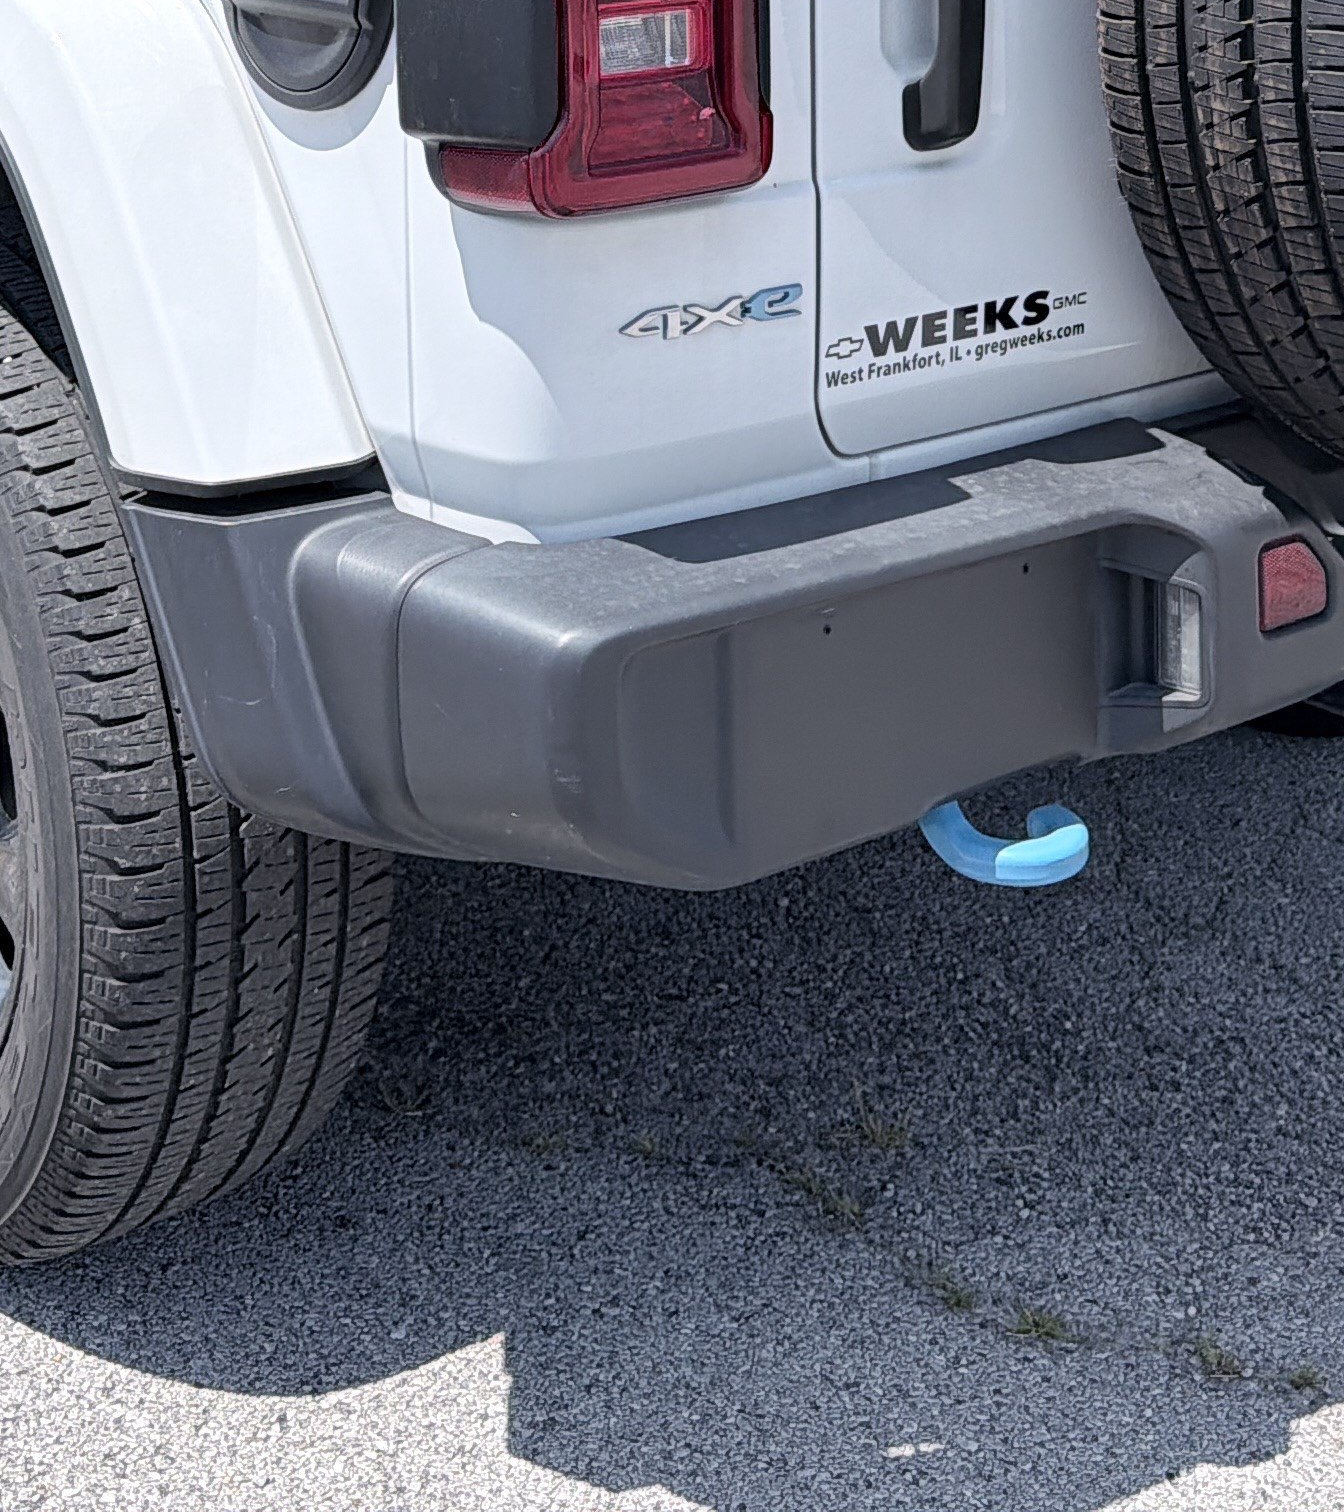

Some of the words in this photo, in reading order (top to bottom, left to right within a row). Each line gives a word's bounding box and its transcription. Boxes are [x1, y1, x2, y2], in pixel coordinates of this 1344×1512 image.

[825, 366, 864, 389] West
[867, 351, 946, 380] Frankfort,
[949, 345, 963, 363] IL
[974, 322, 1085, 362] gregweeks.com
[863, 290, 1051, 358] WEEKS
[1053, 292, 1087, 310] GMC
